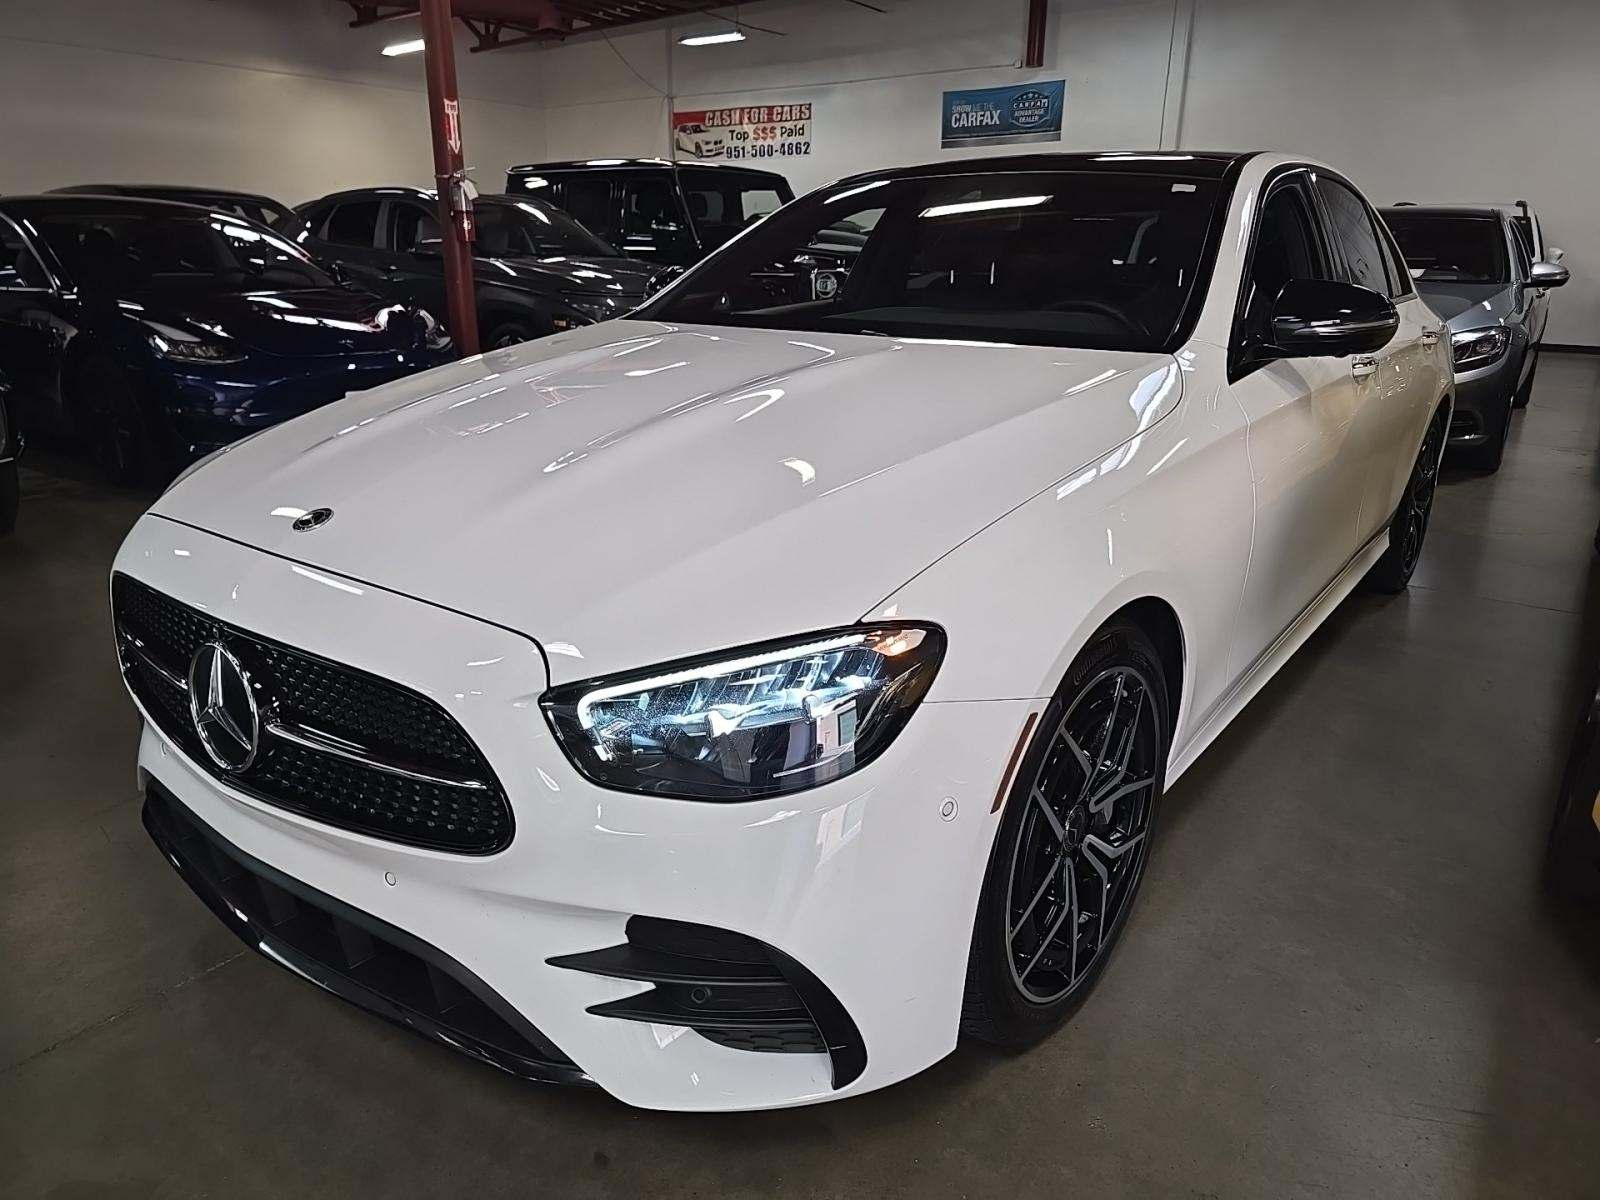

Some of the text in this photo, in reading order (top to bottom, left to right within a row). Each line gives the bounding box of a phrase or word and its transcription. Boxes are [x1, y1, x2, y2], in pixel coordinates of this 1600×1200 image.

[705, 104, 810, 127] CASH FOR CARS
[951, 110, 1000, 128] CARFAX
[729, 124, 805, 142] Top $$$ Paid
[726, 141, 811, 159] 951-500-4862
